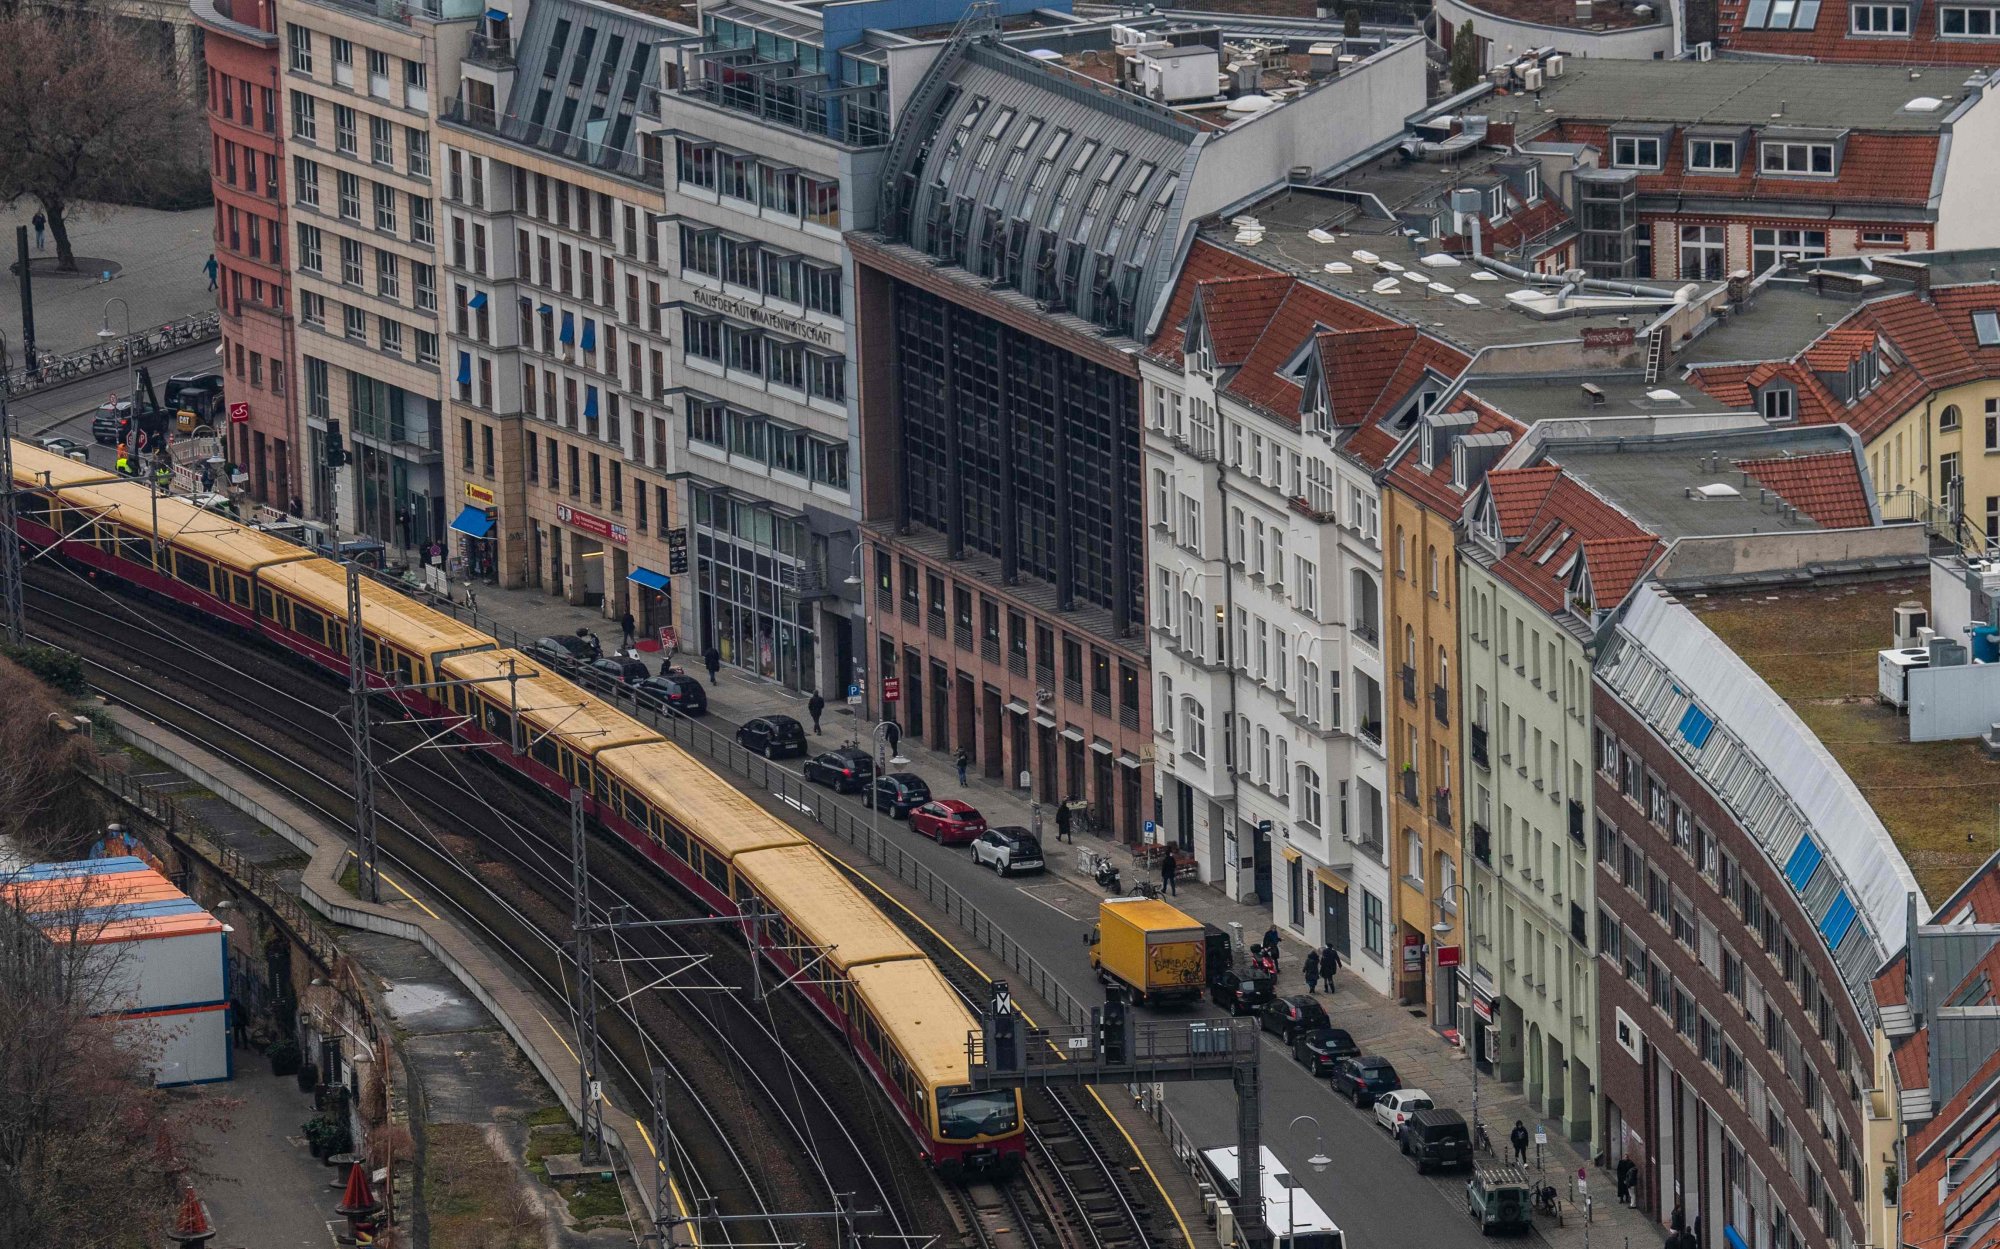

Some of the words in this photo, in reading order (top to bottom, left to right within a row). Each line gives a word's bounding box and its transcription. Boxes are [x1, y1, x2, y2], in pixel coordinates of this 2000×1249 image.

[694, 292, 717, 307] HAUS
[718, 298, 733, 313] DER
[179, 415, 190, 424] CAT
[851, 686, 857, 695] P
[1074, 1039, 1083, 1047] 71
